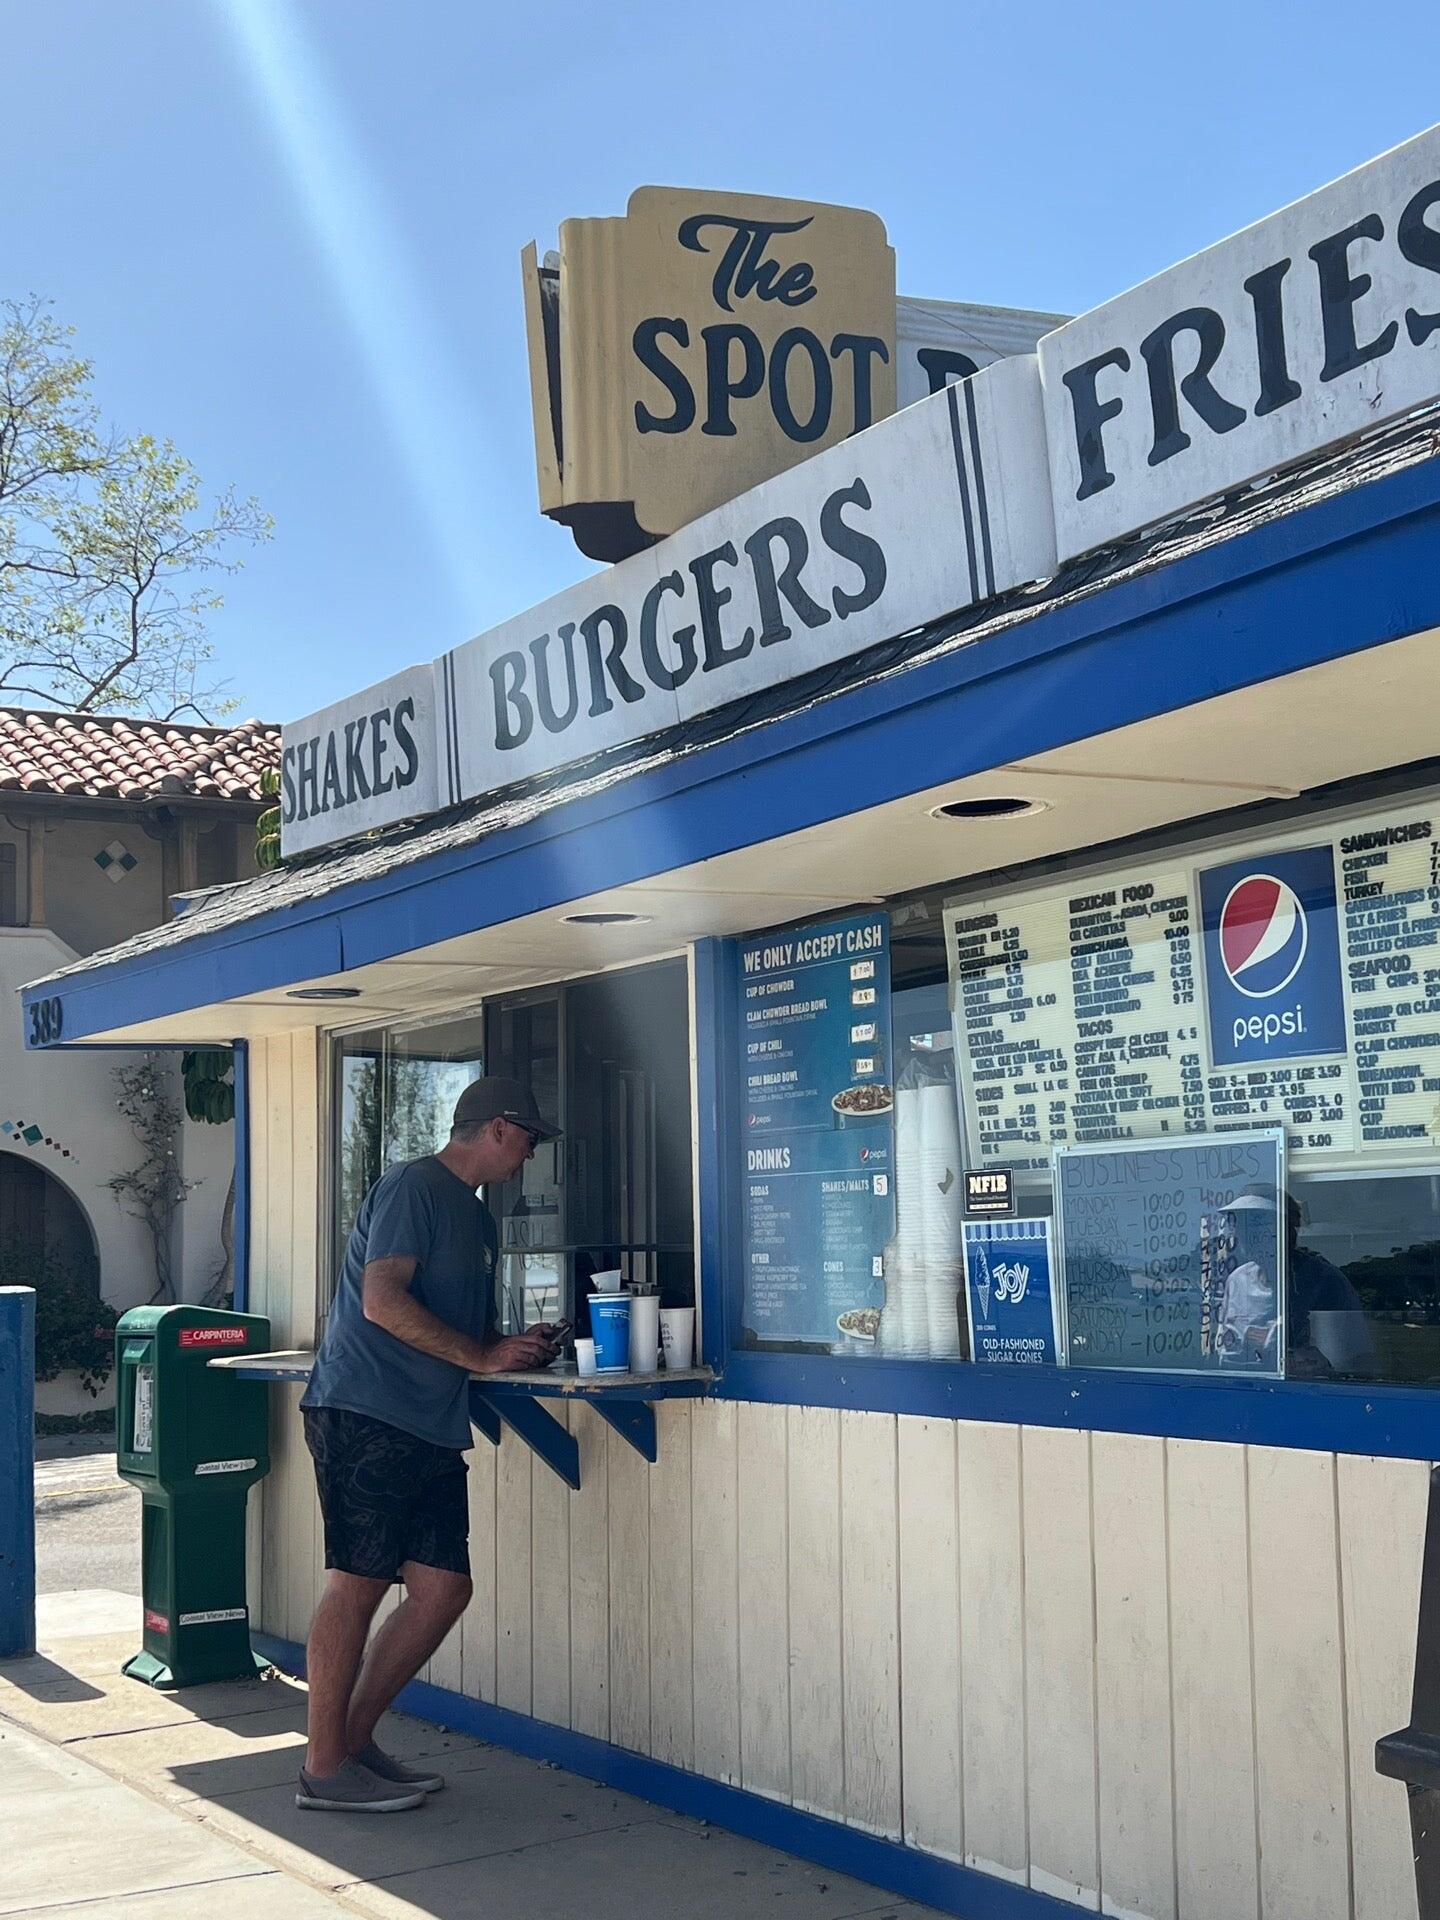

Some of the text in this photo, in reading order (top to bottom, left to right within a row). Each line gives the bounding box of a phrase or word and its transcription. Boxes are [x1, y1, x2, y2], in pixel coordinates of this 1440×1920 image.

[678, 214, 817, 311] The
[1062, 179, 1440, 502] FRIES
[633, 316, 889, 444] SPOT
[489, 478, 888, 752] BURGERS
[281, 698, 418, 826] SHAKES
[1340, 821, 1432, 854] SANDWICHES
[1343, 852, 1388, 872] CHICKEN
[1344, 870, 1368, 886] FISH
[1122, 884, 1154, 904] FOOD
[1344, 882, 1384, 901] TURKEY
[955, 913, 998, 934] BURGERS
[1169, 909, 1188, 923] 9.00
[1347, 923, 1399, 943] PASTRAMI
[743, 924, 882, 973] WE ONLY ACCEPT CASH
[1347, 932, 1437, 957] GRILLED CHEESE
[1348, 955, 1411, 979] SEAFOOD
[746, 980, 795, 999] CUP OF CHOWDER
[1351, 973, 1419, 993] FISH CHIPS
[1037, 994, 1056, 1006] 6.00
[747, 1011, 761, 1023] CLAM
[763, 1005, 790, 1020] CHOWDER
[791, 1001, 810, 1015] BREAD
[810, 998, 828, 1012] BOWL
[1353, 1002, 1411, 1021] SHRIMP OR
[30, 996, 63, 1046] 389
[1077, 1021, 1113, 1038] TACOS
[1234, 1004, 1302, 1047] pepsi
[1355, 1019, 1396, 1036] BASKET
[748, 1039, 782, 1055] CUP OF CHILI
[968, 1030, 1004, 1046] EXTRAS
[1074, 1040, 1104, 1054] CRISPY
[1355, 1039, 1385, 1054] CLAM
[1075, 1053, 1095, 1066] SOFT
[1180, 1054, 1199, 1067] 4.75
[1357, 1054, 1378, 1069] CUP
[748, 1074, 762, 1087] CHILI
[782, 1070, 798, 1083] BOWL
[1099, 1077, 1111, 1089] OR
[1270, 1070, 1291, 1083] 3.00
[1297, 1068, 1315, 1081] LGE
[1318, 1065, 1341, 1079] 3.50
[976, 1086, 1003, 1101] SIDES
[1181, 1080, 1203, 1093] 7.50
[1360, 1083, 1389, 1097] WITH
[1182, 1093, 1205, 1106] 9.00
[1359, 1098, 1385, 1111] CHILI
[979, 1105, 999, 1116] FRIES
[1183, 1107, 1205, 1119] 4.75
[1320, 1108, 1343, 1121] 3.00
[1360, 1112, 1383, 1126] CUP
[1308, 1134, 1331, 1147] 5.00
[747, 1147, 791, 1171] DRINKS
[1066, 1144, 1261, 1189] BUSINESS HOURS
[750, 1185, 769, 1197] SODAS
[875, 1178, 883, 1192] 5
[969, 1174, 1008, 1194] NFIB
[1066, 1196, 1118, 1215] MONDAY
[1143, 1189, 1184, 1213] 10:00
[1066, 1211, 1187, 1236] TUESDAY 10:00
[1144, 1232, 1188, 1253] 10:00
[752, 1253, 844, 1273] OTHER CONES
[874, 1260, 880, 1274] 3
[1144, 1253, 1190, 1277] 10:00
[1069, 1284, 1116, 1304] FRIDAY
[1070, 1308, 1128, 1330] SATURDAY
[193, 1329, 244, 1340] CARPINTERIA
[982, 1338, 1045, 1356] OLD-FASHIONED
[1071, 1331, 1193, 1357] SUNDAY 10:00
[987, 1350, 1042, 1364] SUGAR CONES
[225, 1609, 246, 1619] News
